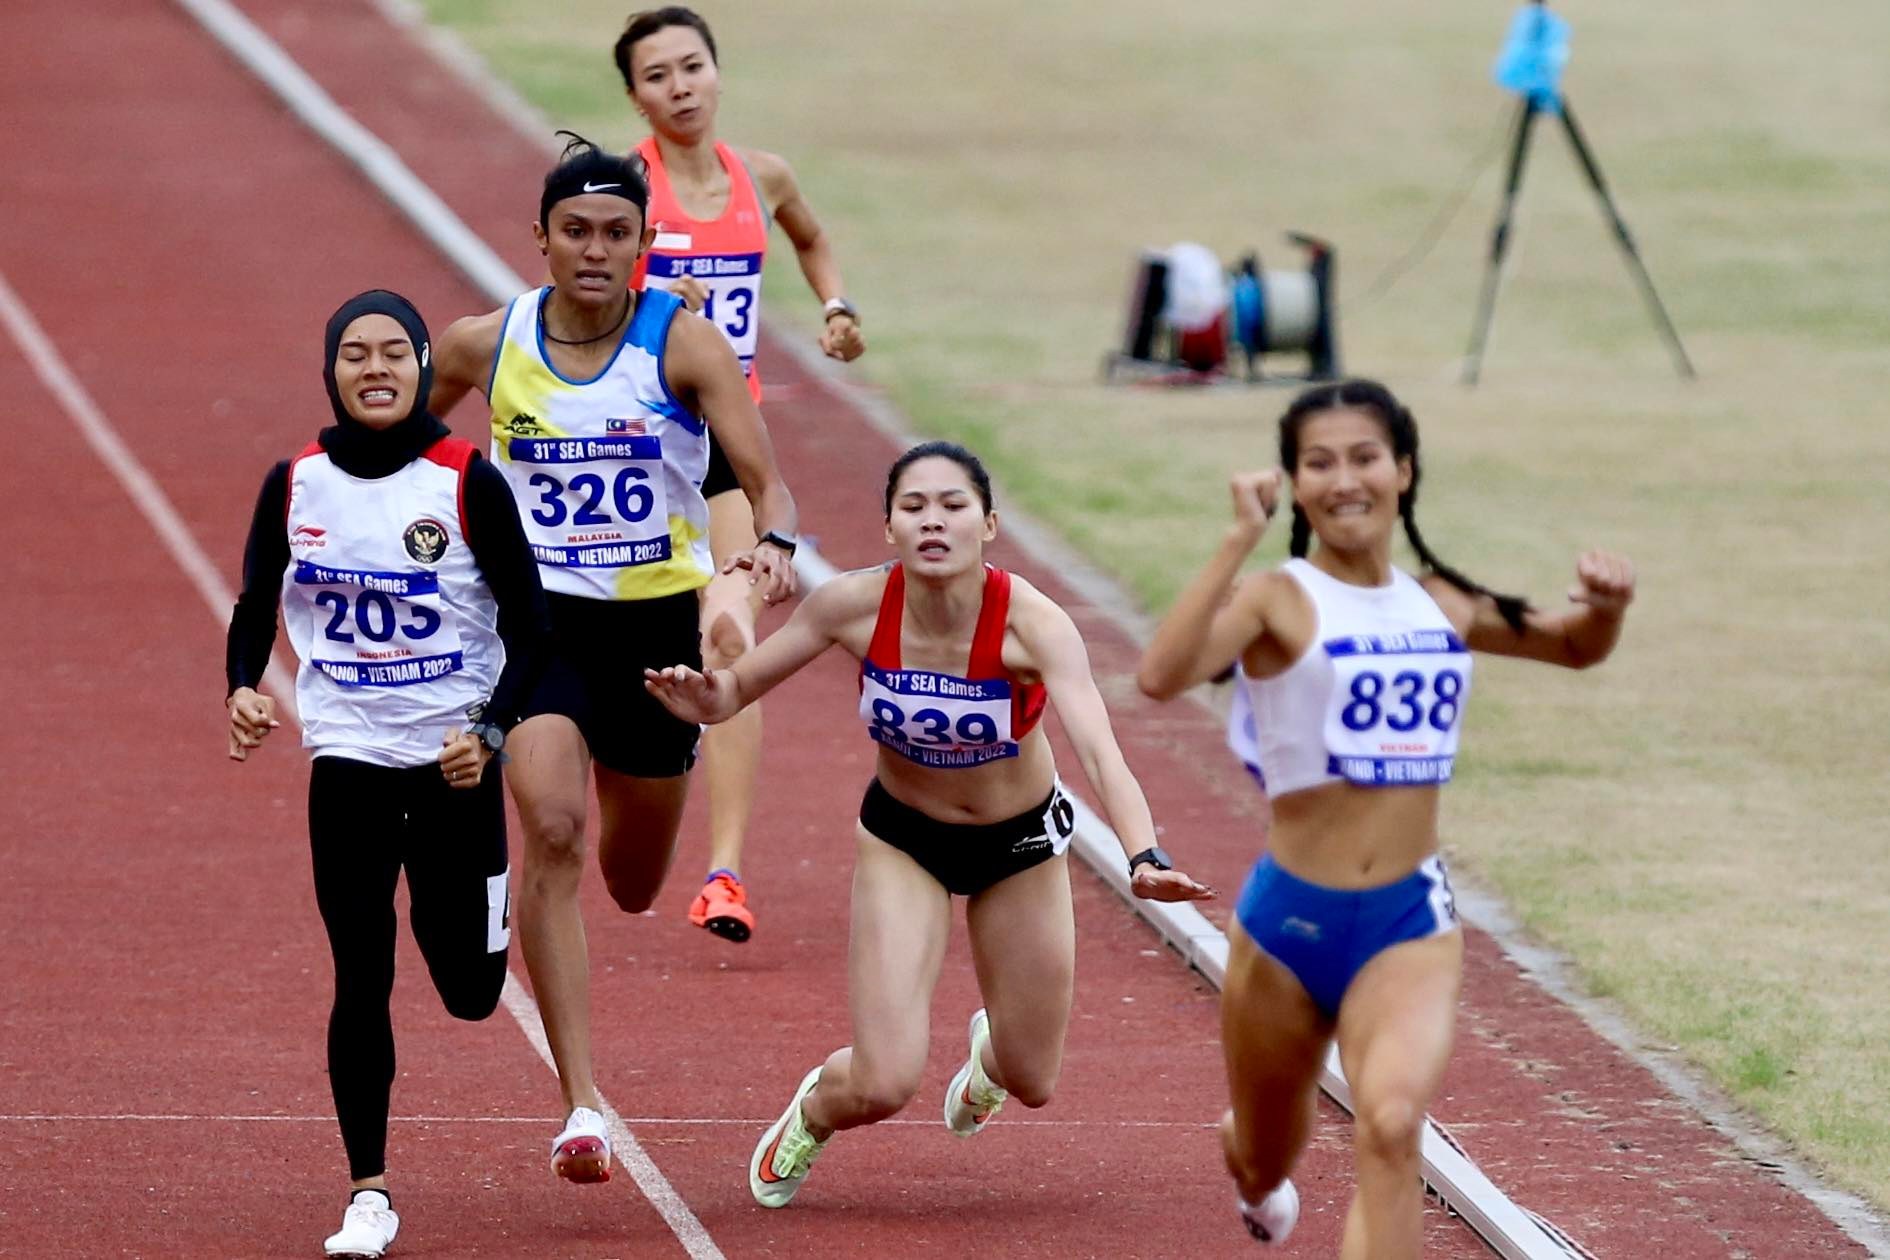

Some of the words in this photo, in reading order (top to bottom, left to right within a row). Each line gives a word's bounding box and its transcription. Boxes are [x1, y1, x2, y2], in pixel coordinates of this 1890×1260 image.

[559, 441, 585, 460] SEA
[587, 441, 632, 458] Games
[529, 467, 655, 527] 326
[568, 532, 622, 543] MALAYSIA
[577, 545, 632, 565] VIETNAM
[633, 542, 663, 561] 2022
[364, 574, 409, 594] Games
[315, 590, 441, 643] 203
[356, 649, 412, 659] INDONESIA
[367, 662, 421, 683] VIETNAM
[422, 657, 453, 678] 2022
[910, 674, 937, 693] SEA
[940, 677, 983, 697] Games
[1341, 669, 1462, 732] 838
[872, 698, 998, 745] 839
[922, 748, 975, 765] VIETNAM
[977, 744, 1007, 762] 2022
